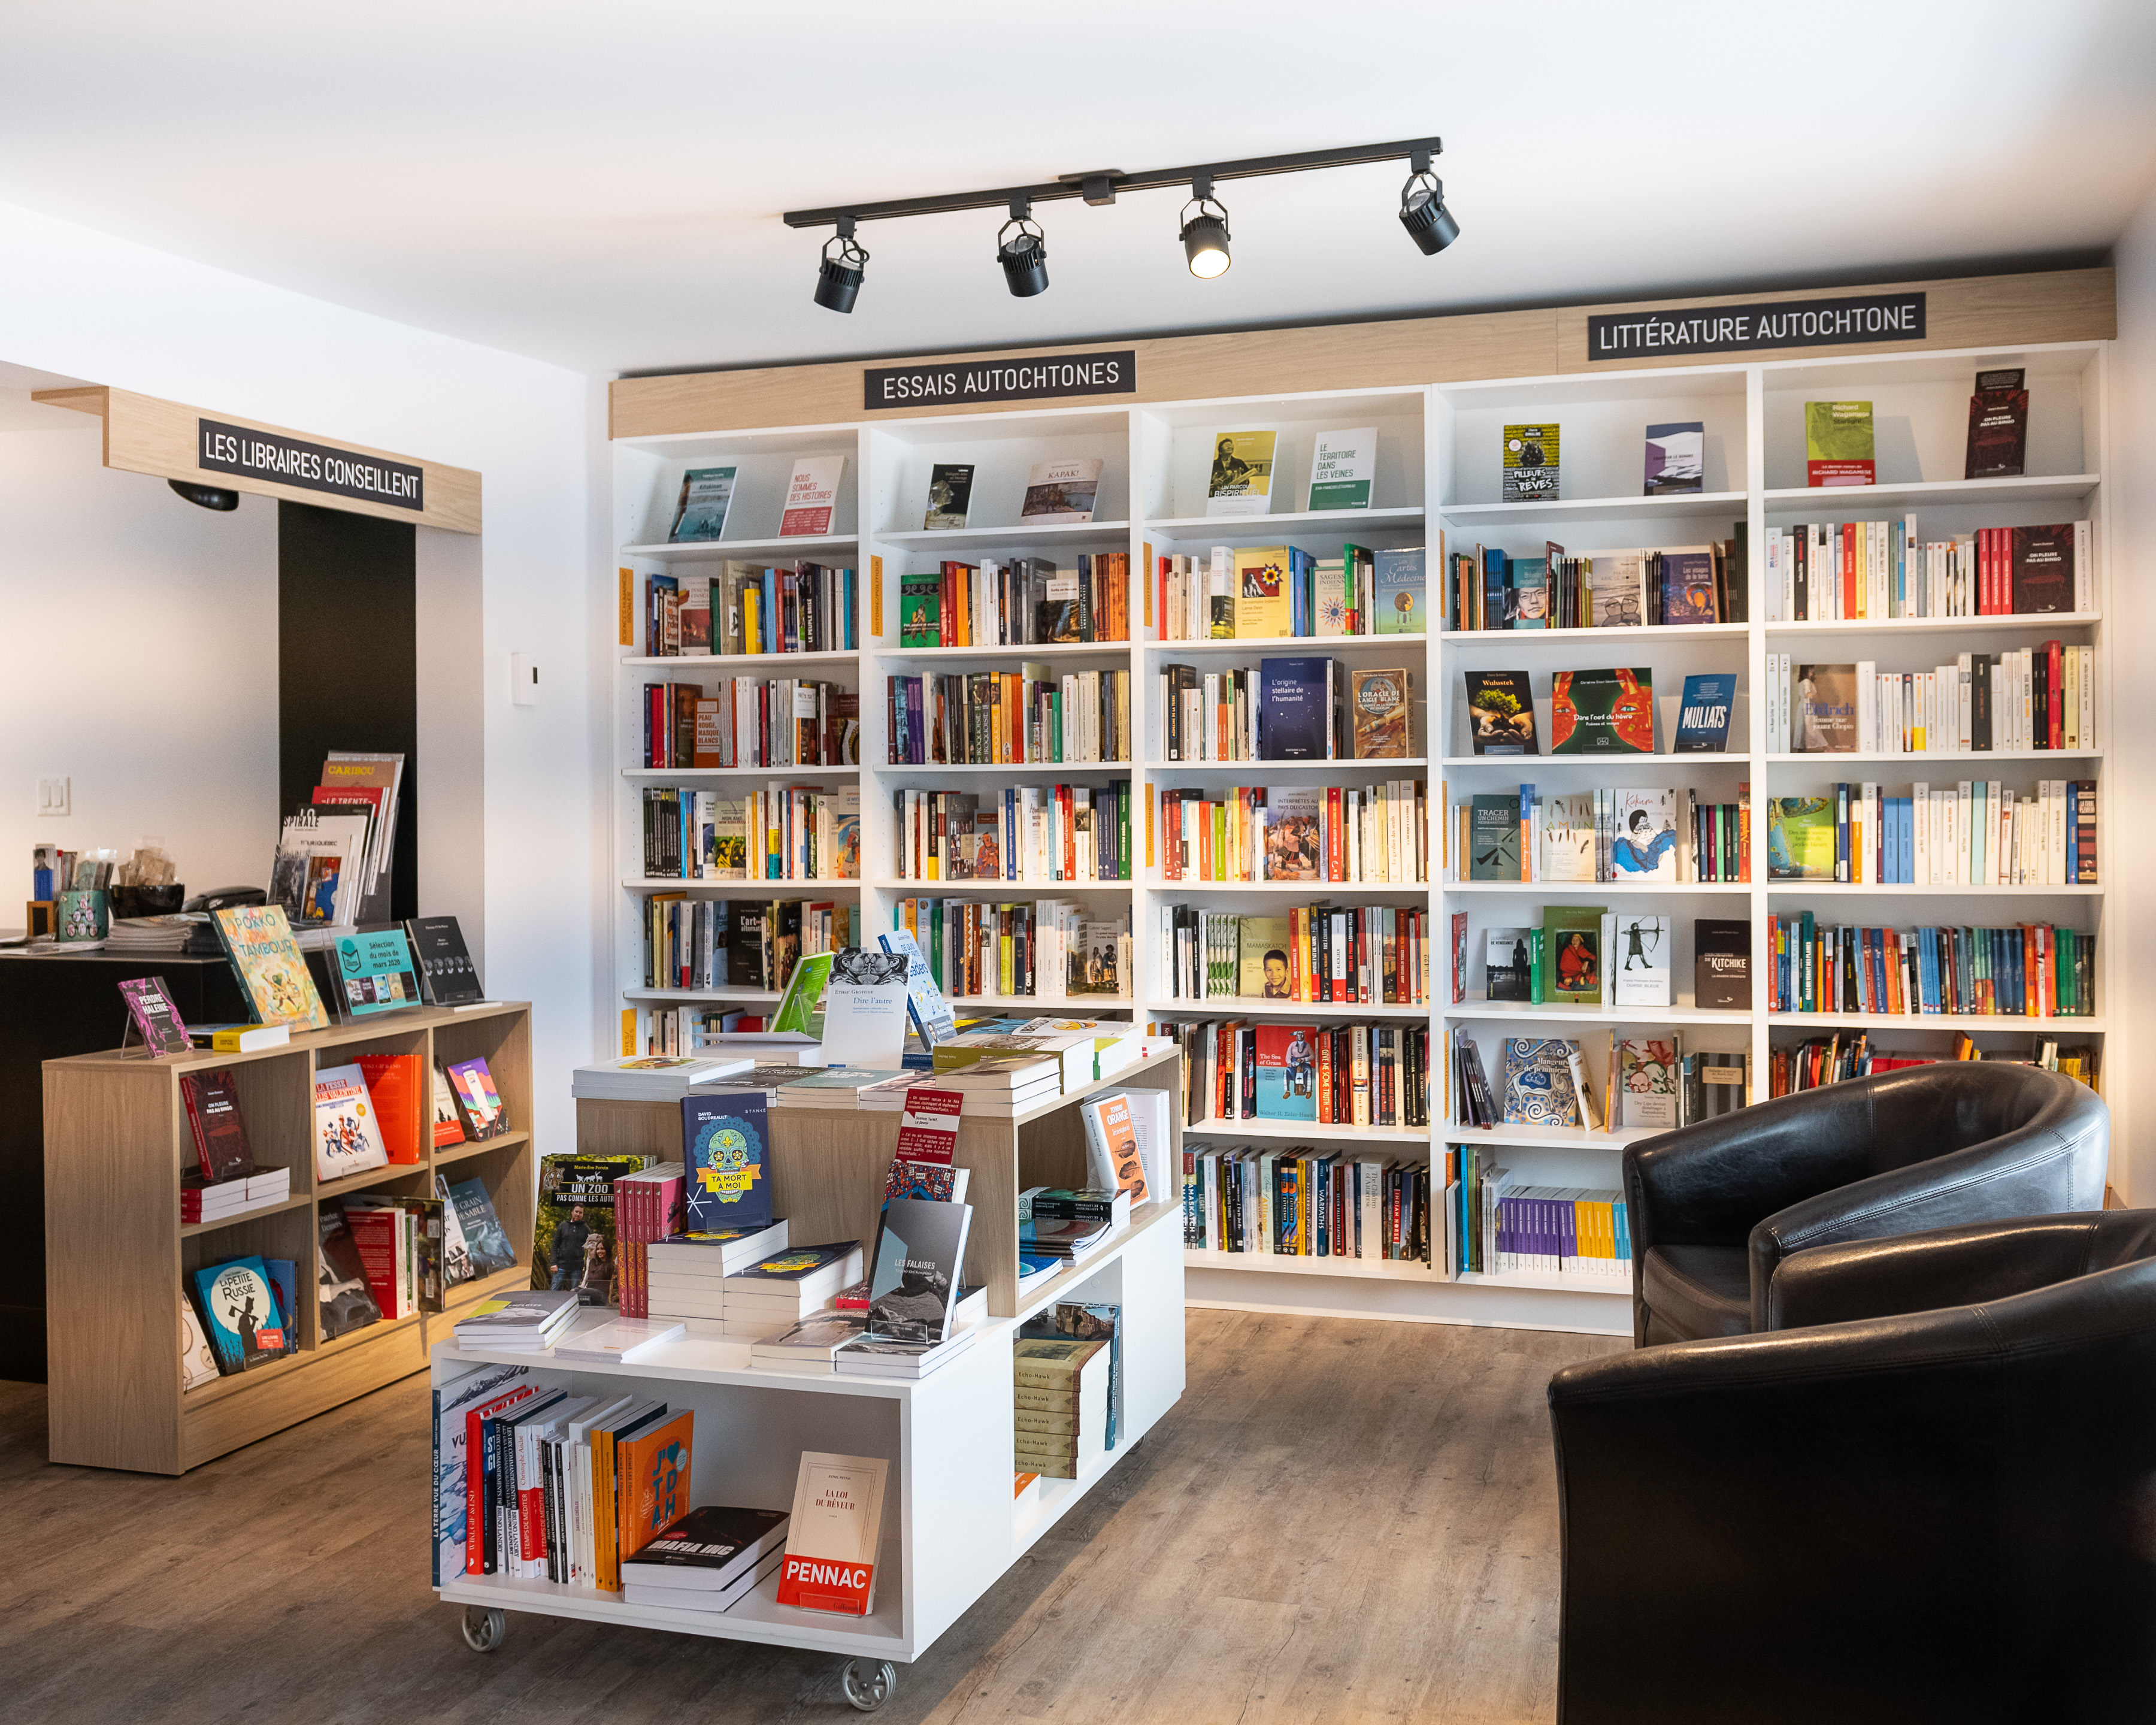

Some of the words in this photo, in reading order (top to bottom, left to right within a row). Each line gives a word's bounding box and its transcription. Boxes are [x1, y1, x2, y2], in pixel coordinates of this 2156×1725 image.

[1600, 316, 1750, 350] LITTÉRATURE
[1757, 305, 1916, 340] AUTOCHTONE
[884, 373, 956, 400] ESSAIS
[964, 361, 1119, 393] AUTOCHTONES
[1319, 450, 1356, 461] TERRITOIRE
[205, 431, 237, 464] LES
[242, 439, 321, 479] LIBRAIRES
[325, 458, 419, 499] CONSEILLENT
[1318, 461, 1336, 470] DANS
[795, 474, 810, 483] NOUS
[1316, 471, 1328, 479] LES
[1330, 469, 1353, 478] VEINES
[1514, 469, 1547, 479] PILLEURS
[792, 482, 817, 492] SOMMES
[1518, 478, 1554, 491] RÊVES
[790, 492, 801, 502] DES
[802, 490, 832, 501] HISTOIRES
[1389, 563, 1418, 574] Cartes
[1806, 703, 1854, 716] Erdrich
[1682, 706, 1727, 729] MULIATS
[328, 765, 375, 775] CARIBOU
[283, 816, 319, 828] SPIRALE
[1547, 821, 1594, 830] AMUN
[234, 913, 276, 930] POKKO
[741, 916, 756, 926] L'art
[239, 939, 293, 958] TAMBOUR
[369, 940, 395, 949] Sélection
[1712, 958, 1746, 971] KITCHIKE
[138, 993, 164, 1006] PERDRE
[142, 1003, 169, 1015] HALEINE
[316, 1092, 329, 1101] LLIS
[329, 1086, 361, 1099] VALENTINE
[1110, 1104, 1123, 1114] TOMMY
[1106, 1110, 1129, 1126] ORANGE
[571, 1184, 587, 1193] UN
[588, 1184, 608, 1194] ZOO
[459, 1196, 482, 1210] GRAIN
[467, 1205, 486, 1218] SABLE
[319, 1212, 338, 1224] Patrice
[320, 1220, 343, 1231] Demers
[895, 1258, 906, 1267] LES
[907, 1260, 935, 1269] FALAISES
[228, 1272, 252, 1285] PETITE
[222, 1284, 256, 1302] RUSSIE
[517, 1454, 526, 1485] Christophe
[433, 1475, 438, 1488] DU
[835, 1490, 848, 1499] LOI
[826, 1499, 855, 1511] RÊVEUR
[523, 1521, 528, 1529] DE
[647, 1541, 701, 1555] MAFIA
[702, 1546, 735, 1556] INC
[786, 1560, 867, 1589] PENNAC
